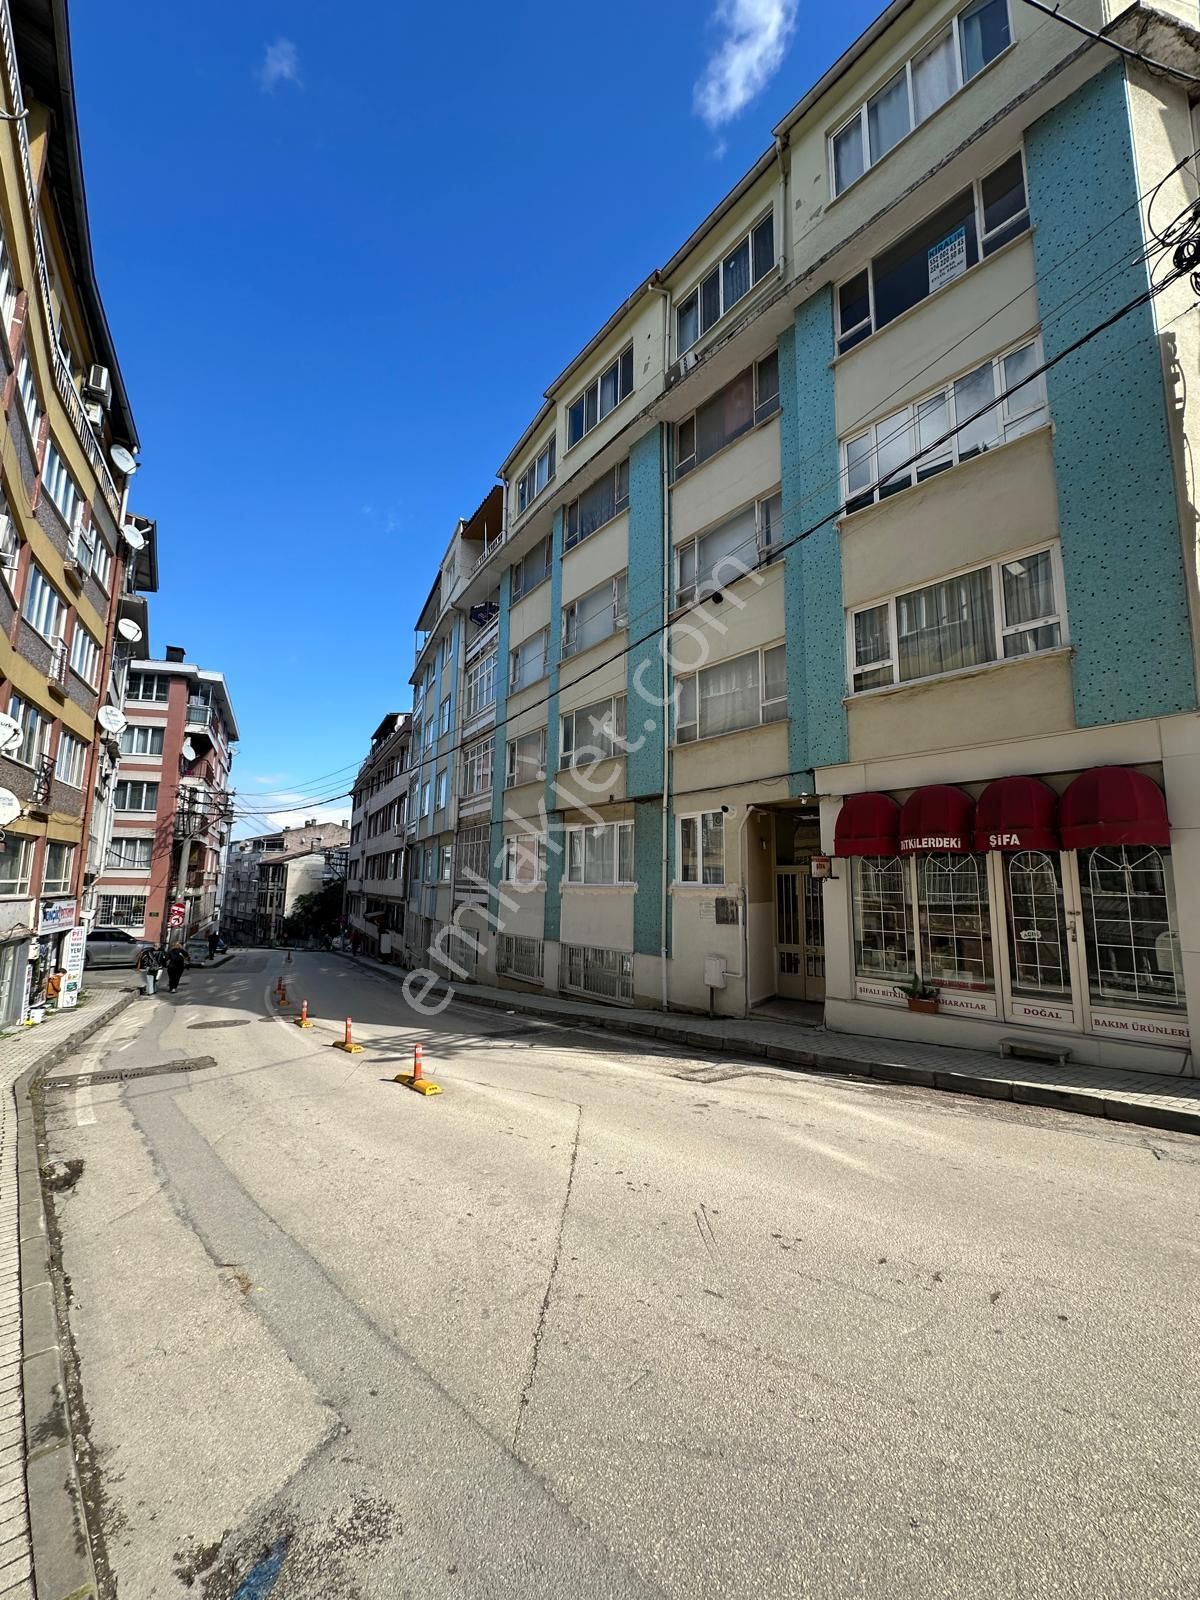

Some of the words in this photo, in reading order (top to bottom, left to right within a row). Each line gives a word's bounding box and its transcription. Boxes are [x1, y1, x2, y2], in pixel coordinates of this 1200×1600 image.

[929, 227, 965, 259] KIRALIK
[989, 834, 1020, 847] ŞİFA
[859, 986, 880, 995] ŞİFALI
[937, 998, 987, 1010] AHARATLAR
[1023, 1007, 1062, 1019] DOĞAL
[1094, 1019, 1129, 1030] BAKIM
[1131, 1022, 1191, 1038] ÜRÜNLERİ
